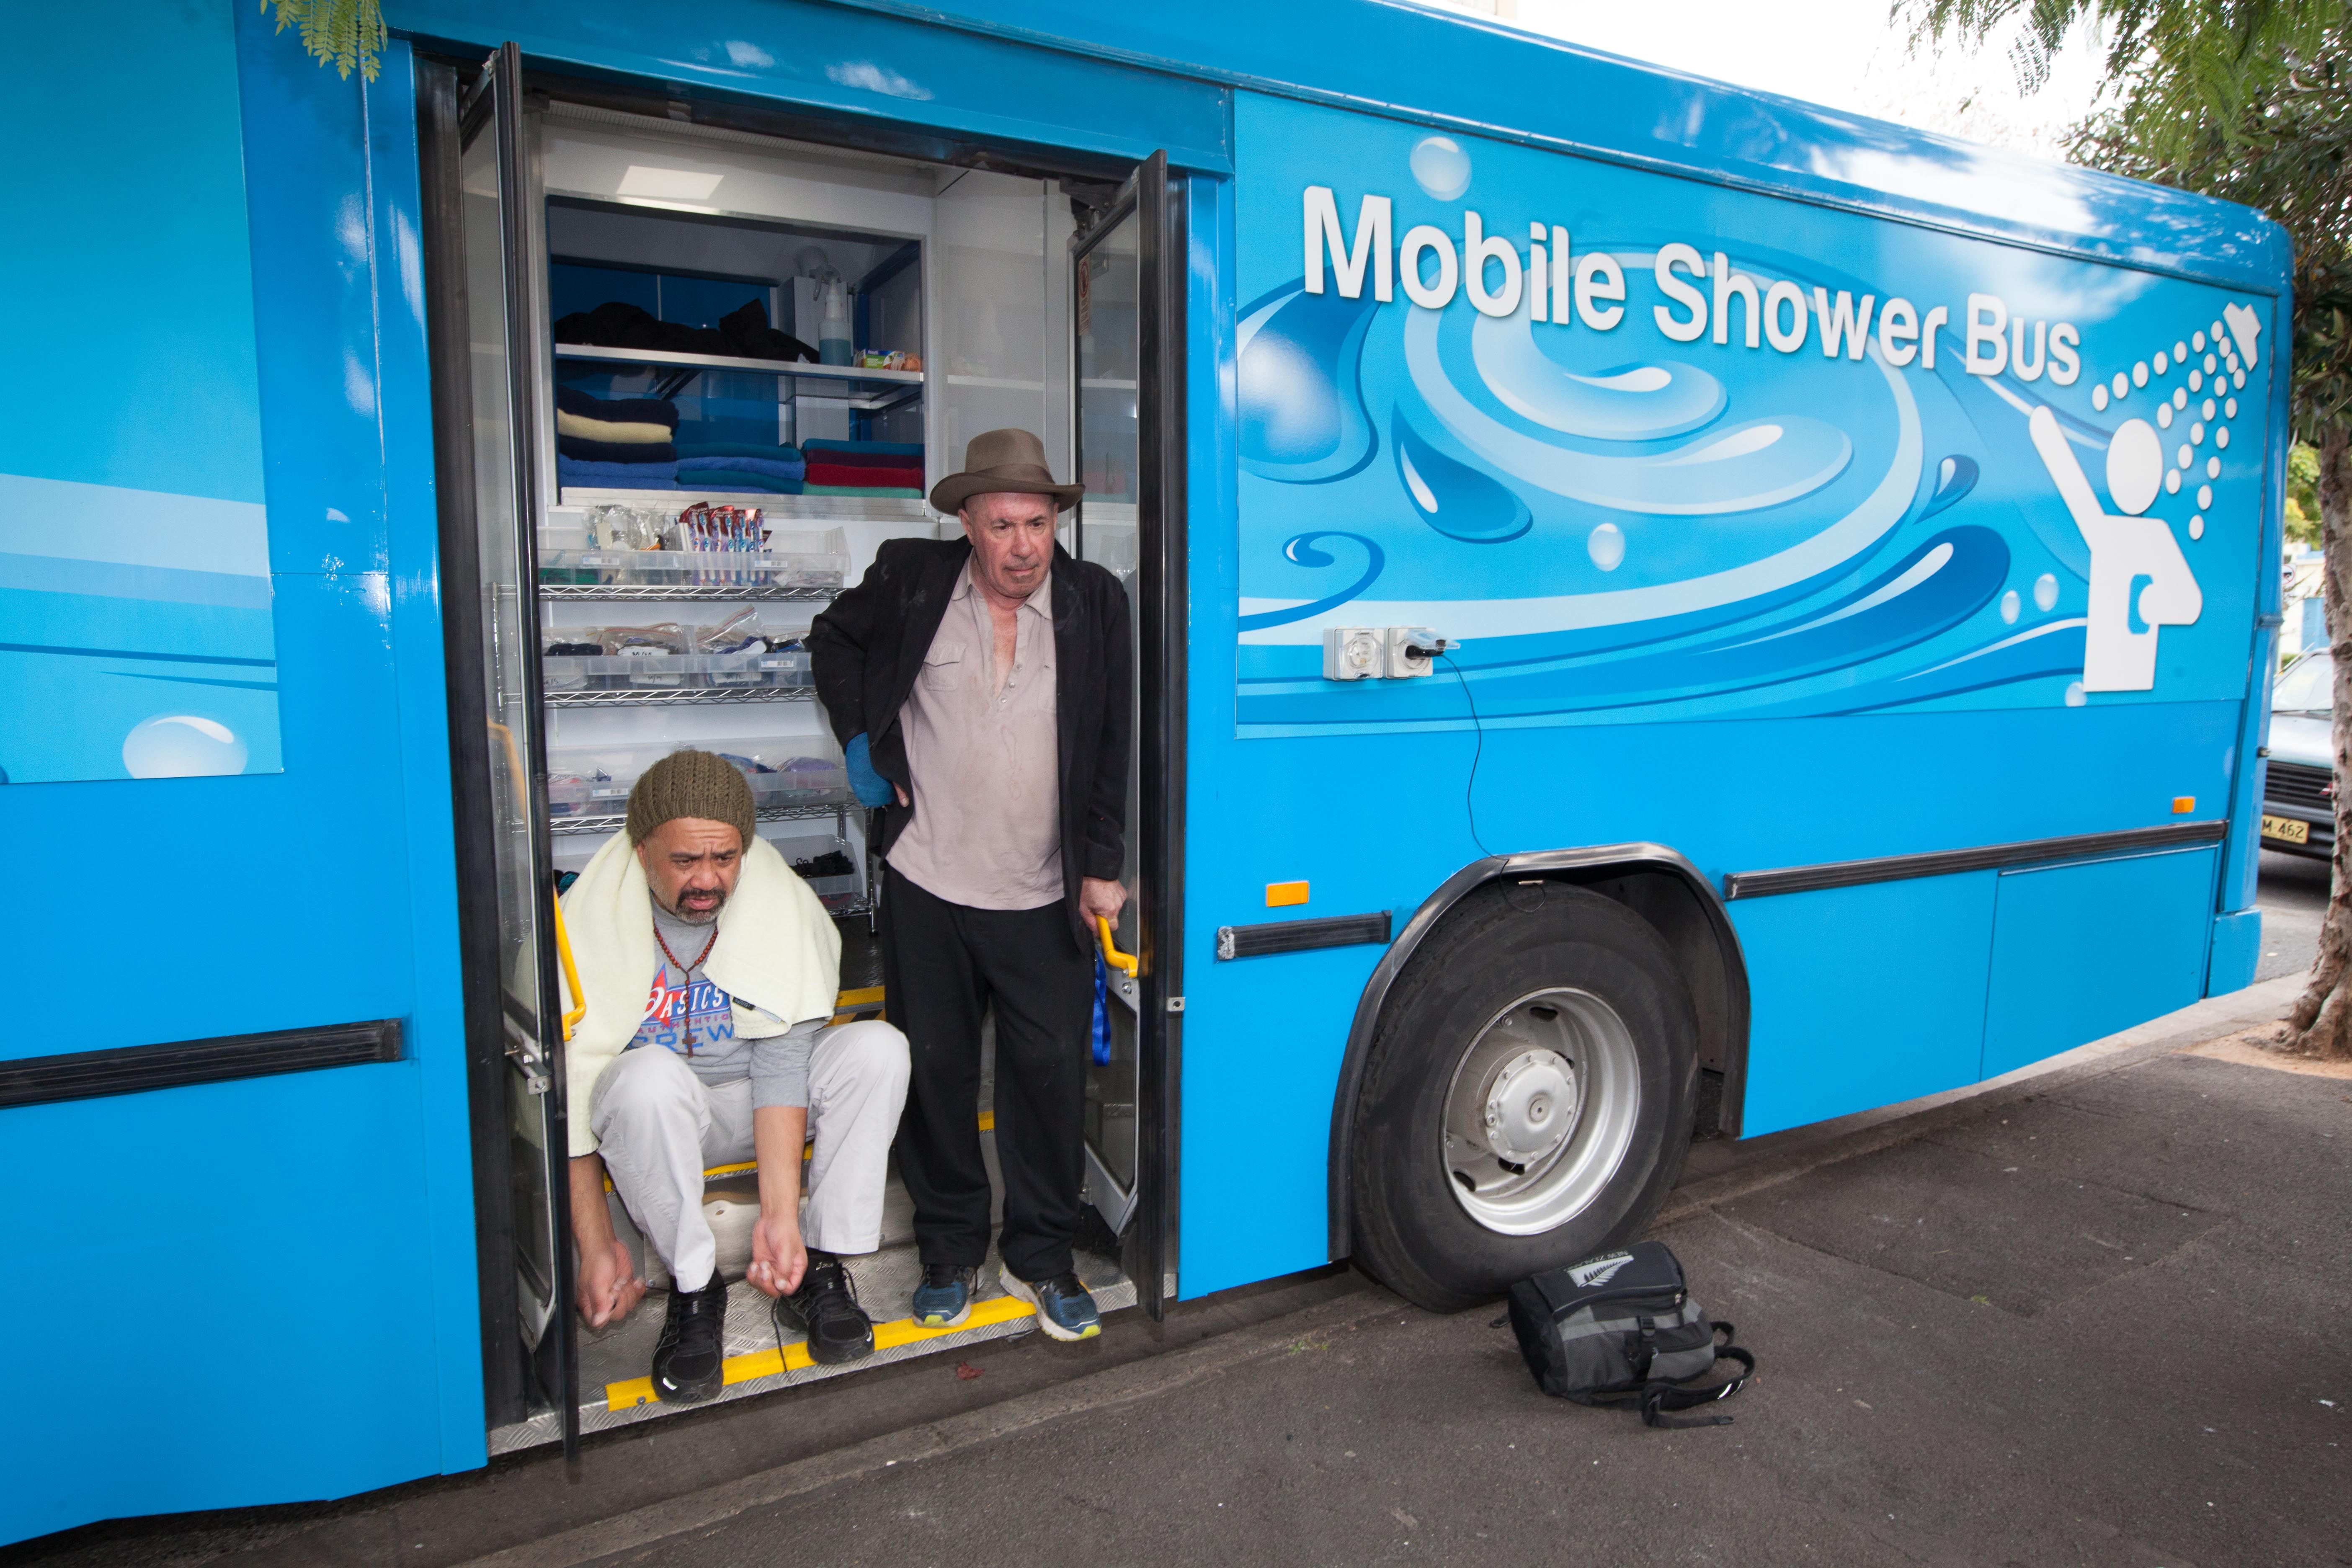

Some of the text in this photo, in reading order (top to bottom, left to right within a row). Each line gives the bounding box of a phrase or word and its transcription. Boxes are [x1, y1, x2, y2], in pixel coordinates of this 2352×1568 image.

[1303, 186, 2081, 386] Mobile Shower Bus
[2277, 823, 2304, 839] 462
[659, 985, 724, 1019] ASICS
[629, 1024, 733, 1052] CREW
